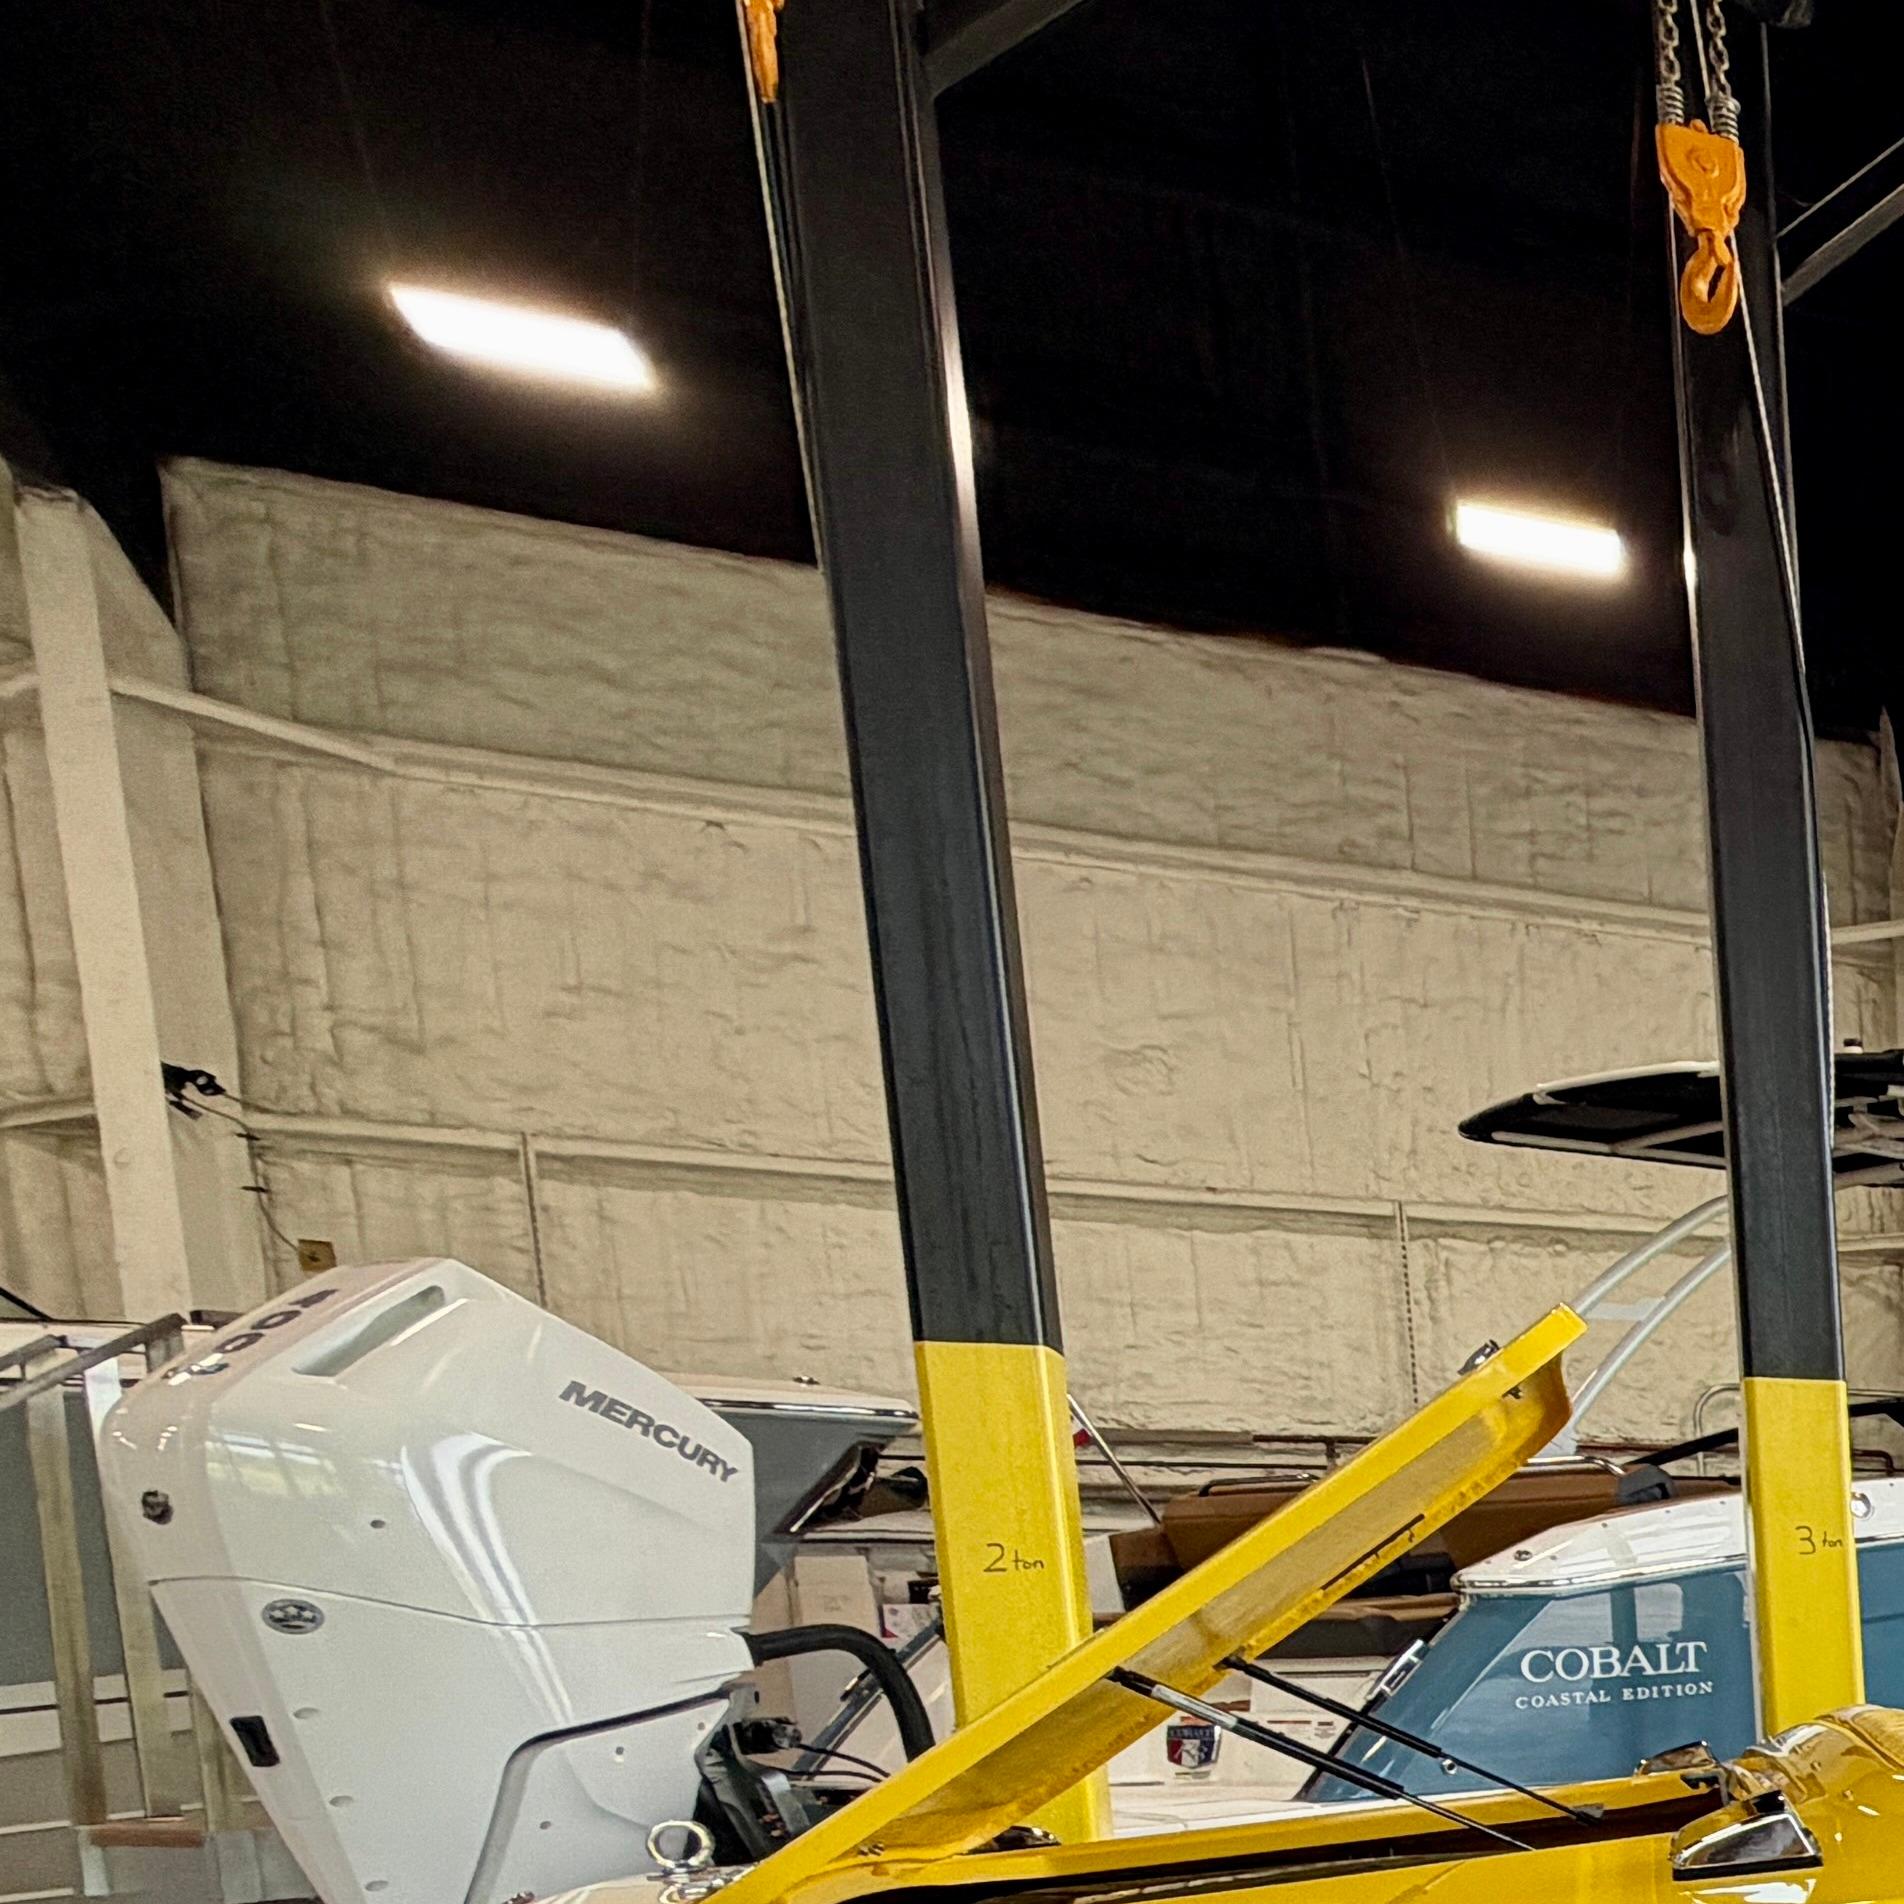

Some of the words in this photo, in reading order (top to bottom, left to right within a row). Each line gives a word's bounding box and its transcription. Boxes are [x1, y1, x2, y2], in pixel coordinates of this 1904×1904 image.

[559, 1380, 738, 1482] MERCURY
[1795, 1525, 1816, 1555] 3
[1822, 1531, 1843, 1547] ton
[983, 1543, 1007, 1572] 2
[1012, 1549, 1044, 1570] ton
[1520, 1641, 1708, 1683] COBALT
[1515, 1690, 1611, 1709] COASTAL
[1622, 1681, 1714, 1700] EDITION
